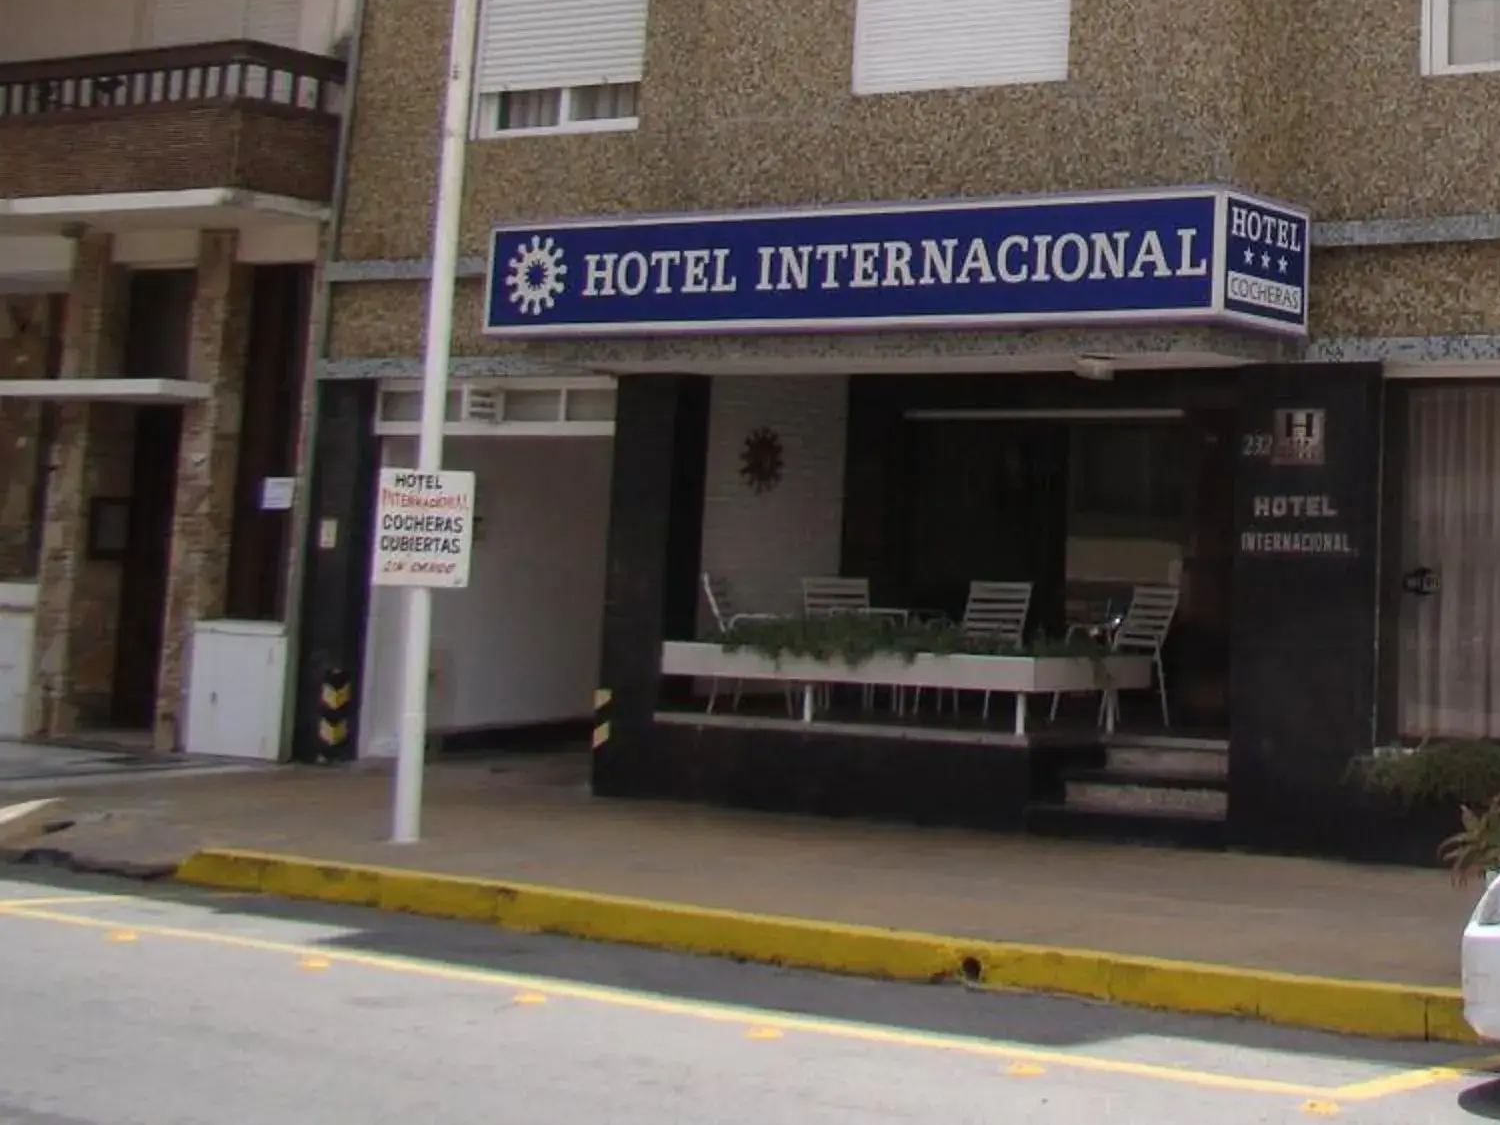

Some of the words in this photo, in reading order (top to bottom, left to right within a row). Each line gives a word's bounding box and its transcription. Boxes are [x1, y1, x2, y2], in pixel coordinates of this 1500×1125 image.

[1231, 206, 1301, 252] HOTEL
[583, 248, 737, 297] HOTEL
[755, 229, 1208, 290] INTERNACIONAL
[1231, 276, 1299, 309] COCHERAS
[395, 474, 443, 491] HOTEL
[1253, 495, 1338, 517] HOTEL
[383, 514, 465, 534] COCHERAS
[380, 535, 461, 555] CUBIERTAS
[1241, 531, 1353, 553] INTERNACIONAL
